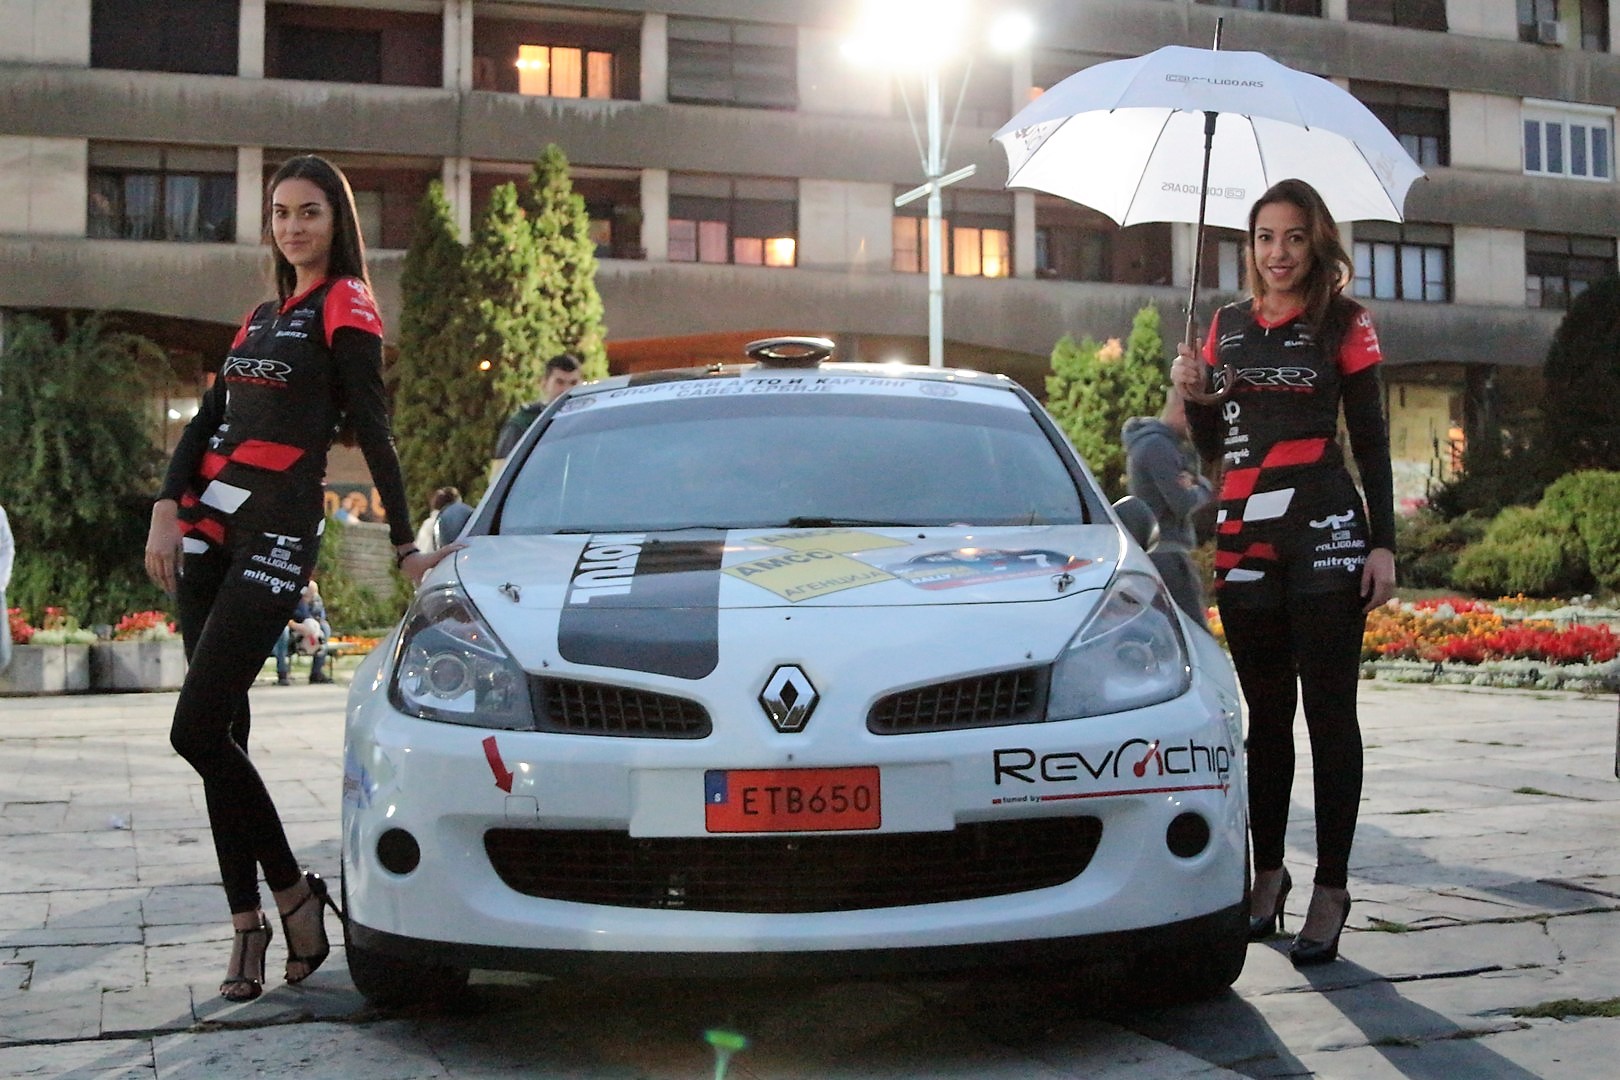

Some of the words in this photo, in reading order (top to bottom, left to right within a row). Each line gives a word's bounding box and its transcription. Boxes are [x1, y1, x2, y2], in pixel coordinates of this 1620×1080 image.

[1240, 80, 1264, 88] ARS
[729, 377, 781, 386] АУТО
[815, 378, 912, 387] КАРТИНГ
[569, 534, 647, 604] MOTUL
[742, 785, 872, 816] ETB650
[1003, 796, 1028, 804] tuned
[1029, 795, 1041, 803] by
